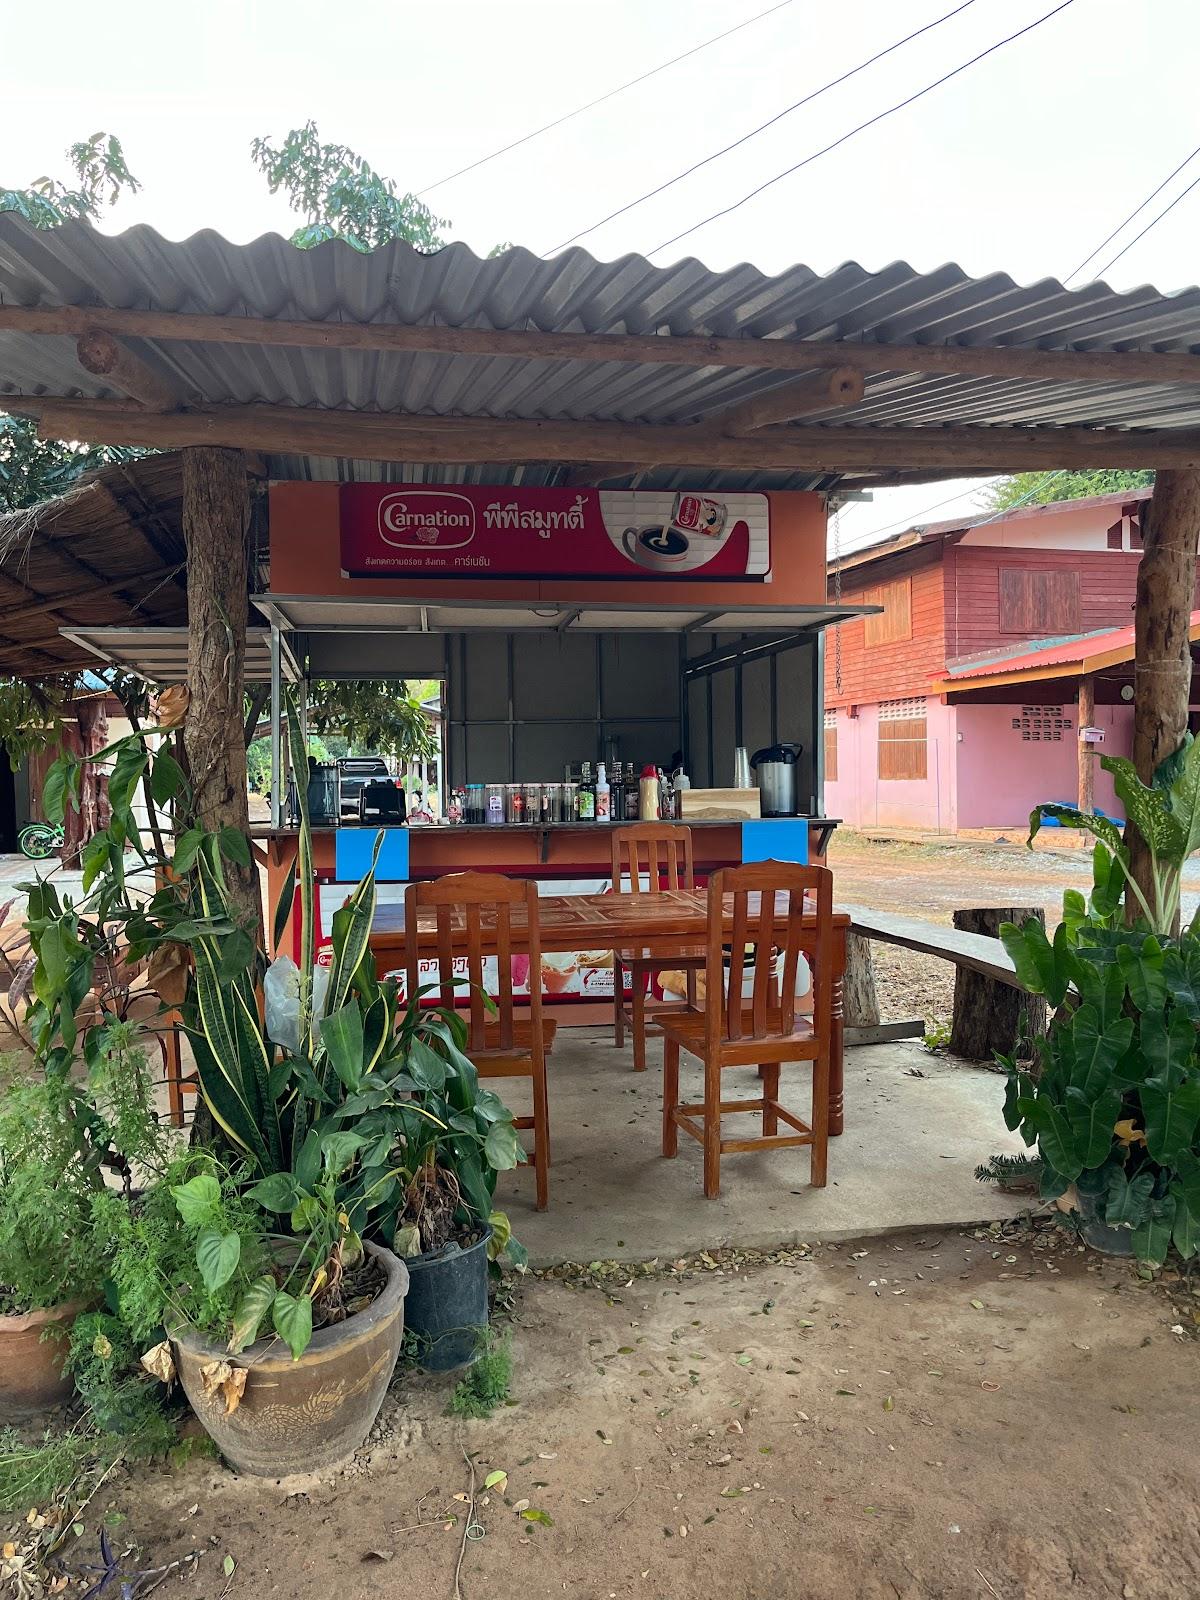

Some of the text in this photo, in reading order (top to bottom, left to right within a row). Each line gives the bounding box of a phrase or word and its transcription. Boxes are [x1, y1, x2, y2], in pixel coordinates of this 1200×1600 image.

[384, 502, 470, 532] Carnation
[483, 494, 589, 539] พีพีสมูทตี้
